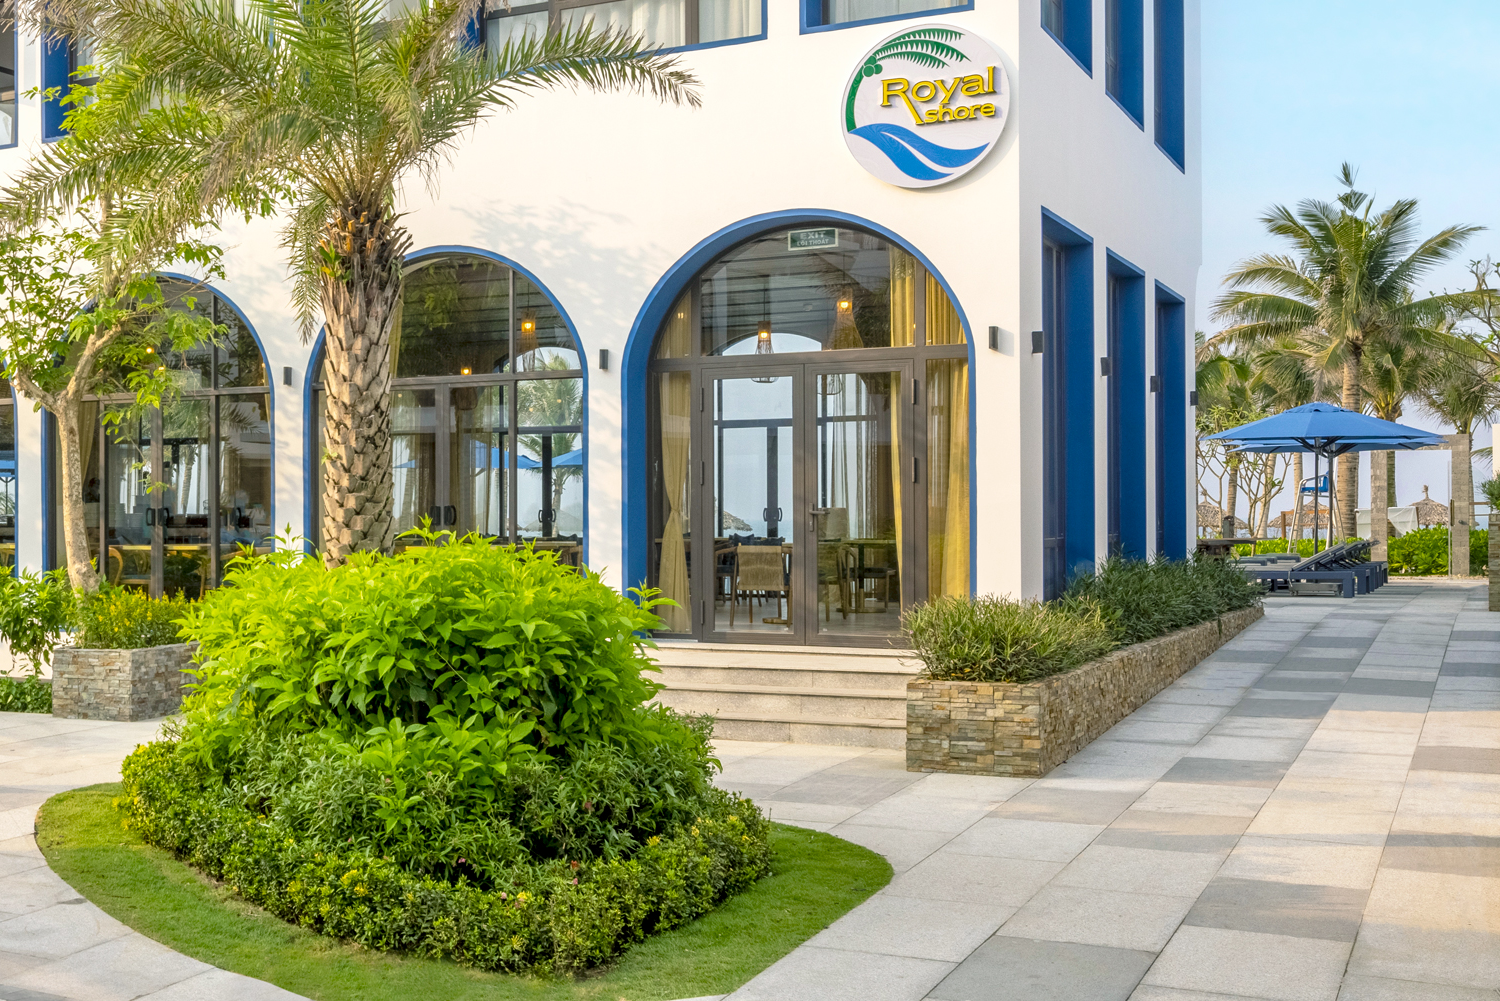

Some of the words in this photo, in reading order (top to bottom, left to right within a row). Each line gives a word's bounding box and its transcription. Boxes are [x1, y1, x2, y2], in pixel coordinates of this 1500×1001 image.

[880, 65, 997, 126] Royal
[923, 101, 996, 124] shore
[800, 231, 826, 240] EXIT
